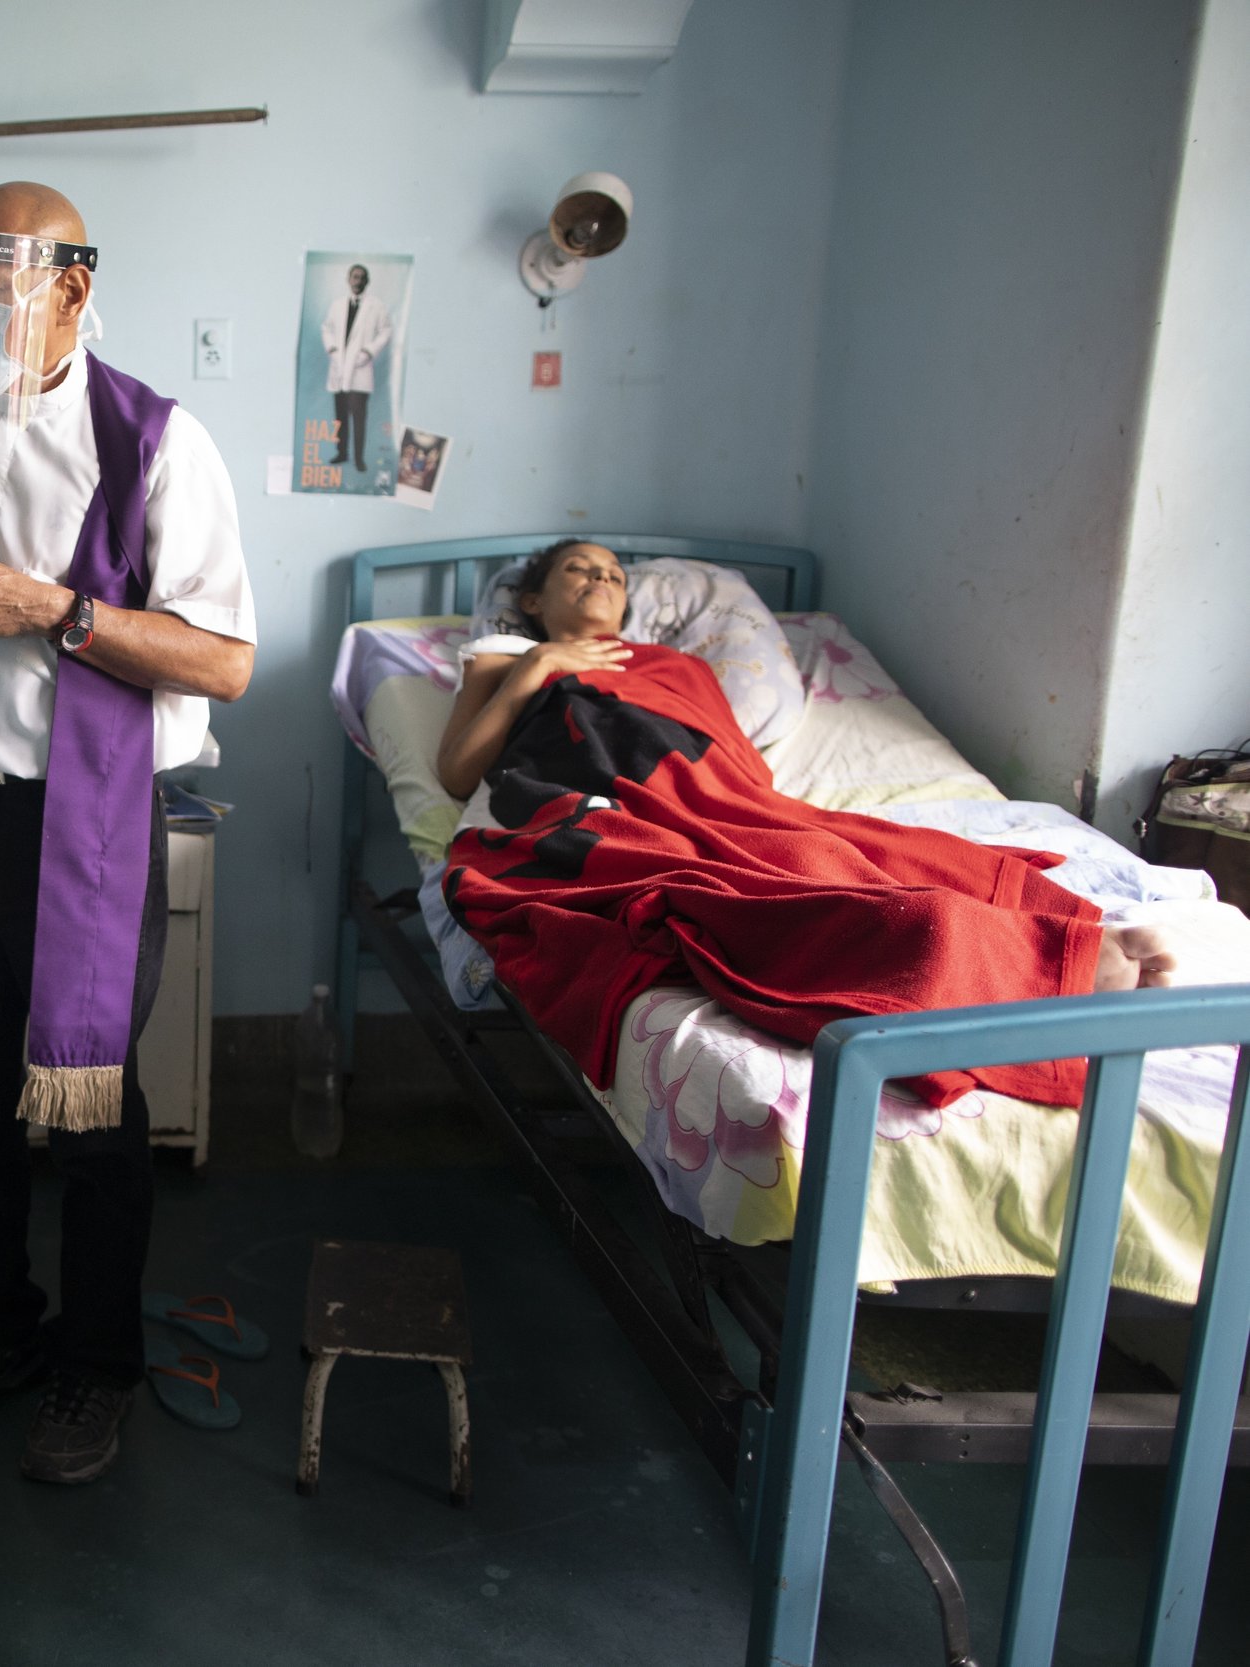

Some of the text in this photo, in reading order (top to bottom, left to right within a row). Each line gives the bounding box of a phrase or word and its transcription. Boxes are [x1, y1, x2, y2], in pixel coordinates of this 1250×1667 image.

[304, 418, 341, 443] HAZ
[303, 443, 323, 464] EL
[301, 465, 343, 488] BIEN
